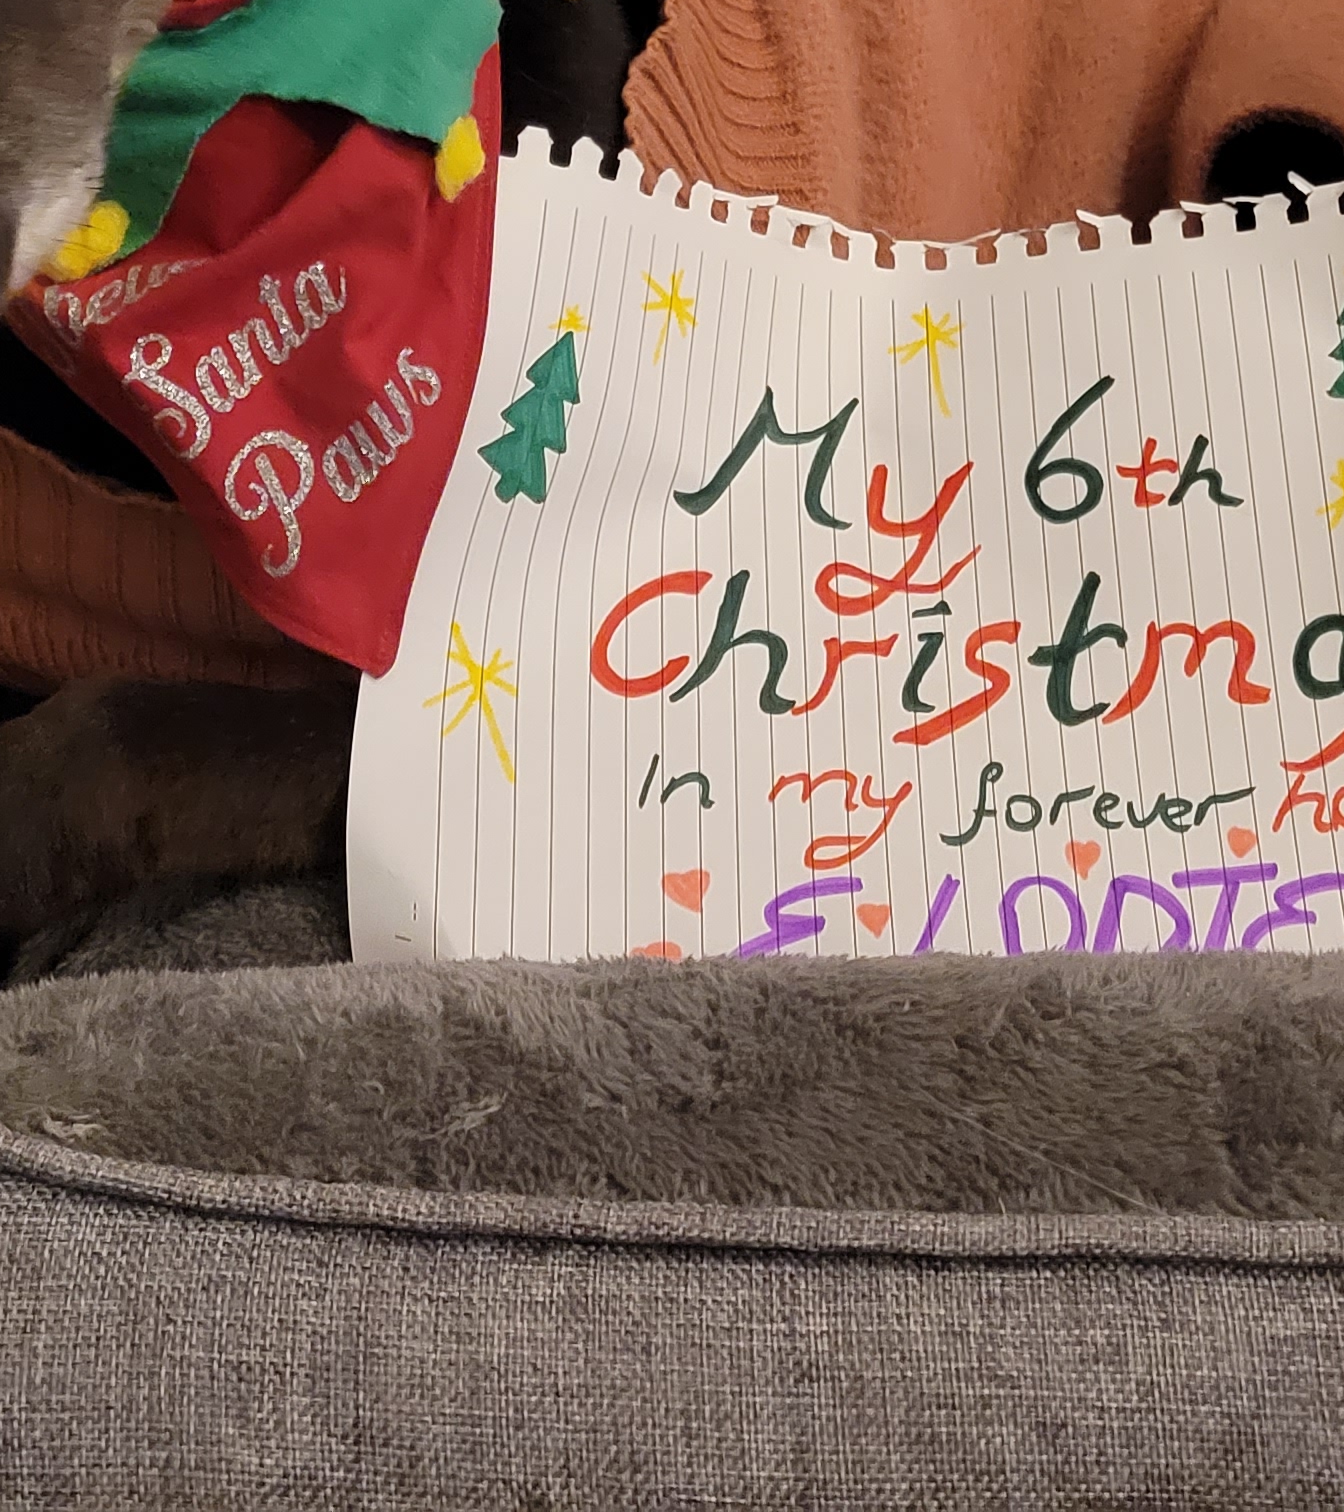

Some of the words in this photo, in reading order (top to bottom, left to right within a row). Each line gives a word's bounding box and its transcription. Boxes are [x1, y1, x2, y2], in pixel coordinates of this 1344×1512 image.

[120, 261, 347, 460] Santa
[223, 346, 442, 579] Paws
[673, 385, 982, 616] My
[1024, 375, 1245, 524] 6th
[768, 767, 913, 870] my
[940, 761, 1256, 846] forever
